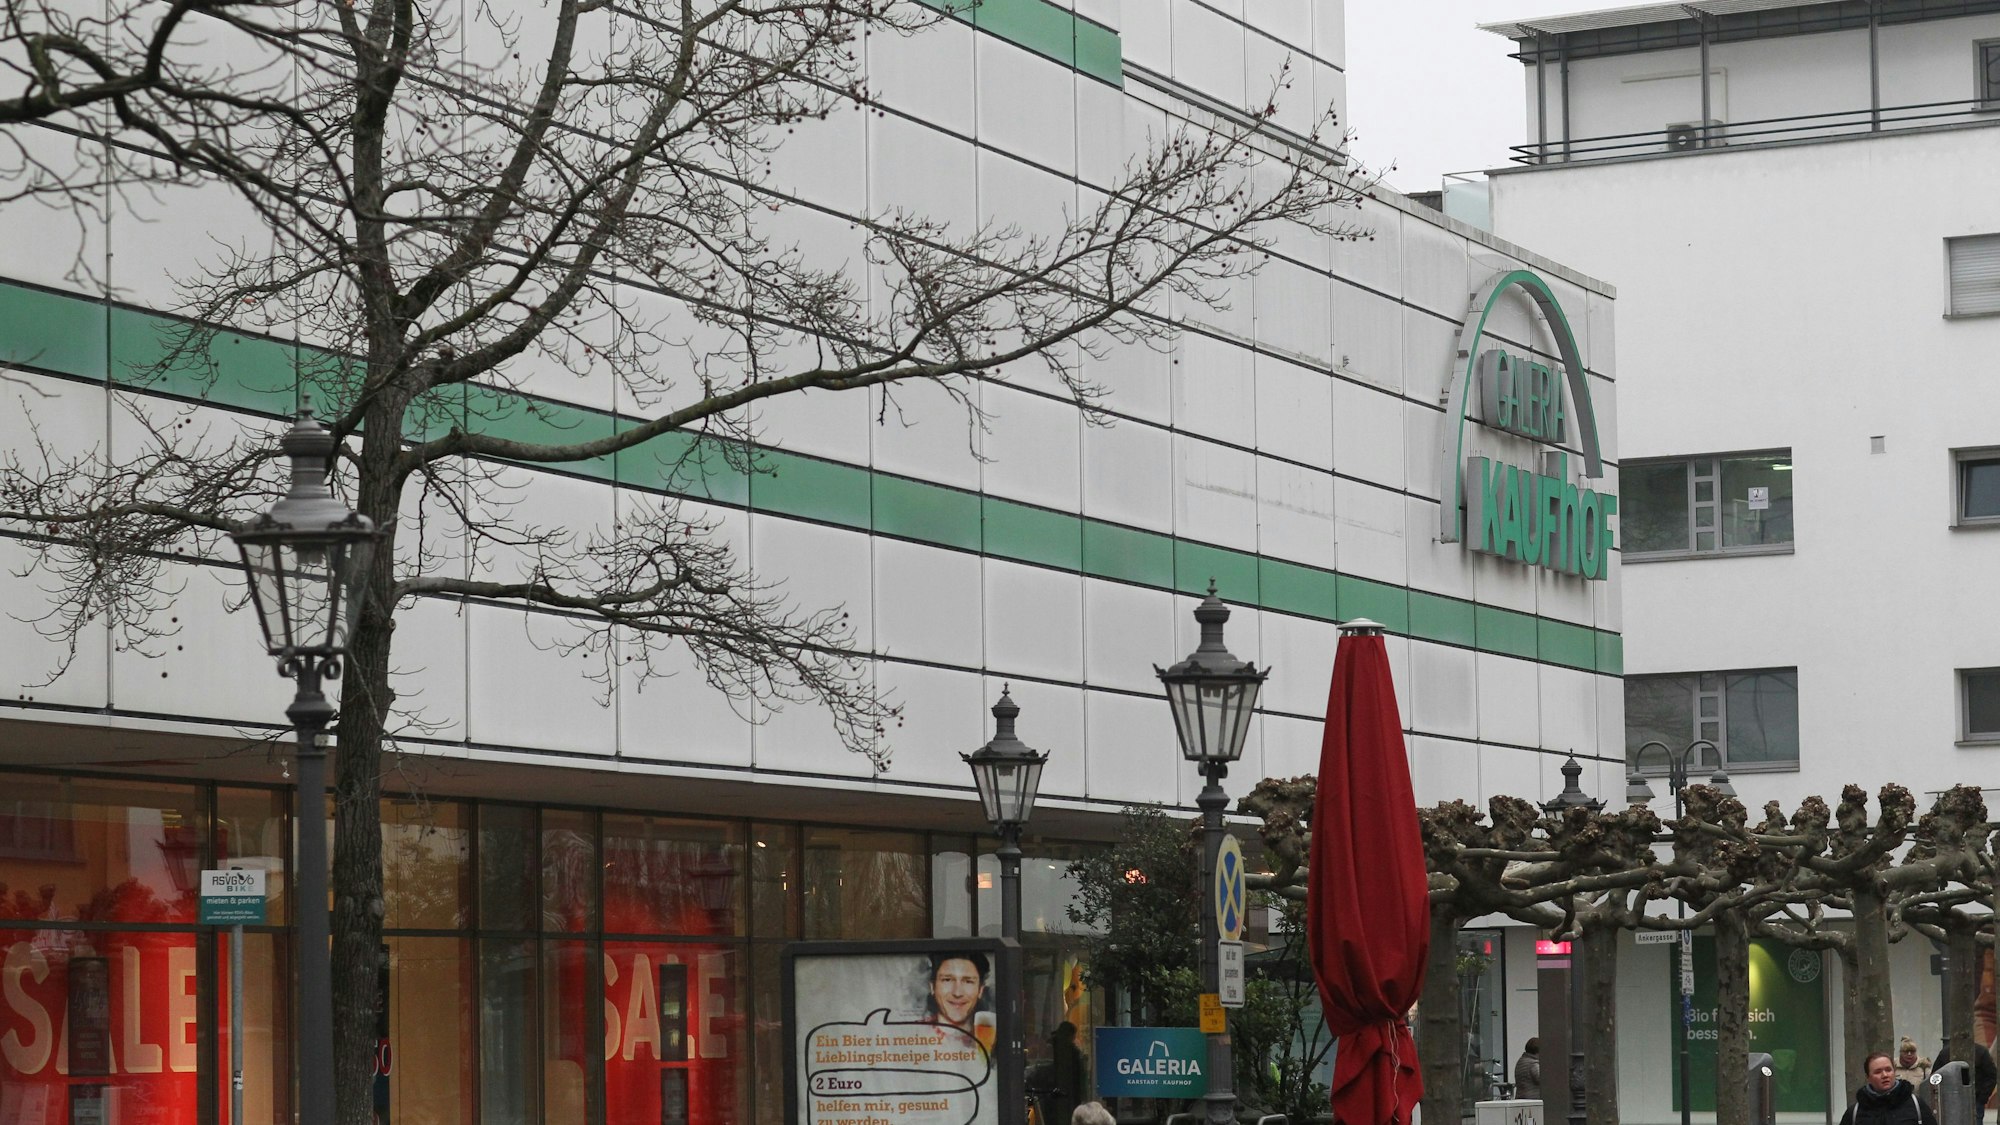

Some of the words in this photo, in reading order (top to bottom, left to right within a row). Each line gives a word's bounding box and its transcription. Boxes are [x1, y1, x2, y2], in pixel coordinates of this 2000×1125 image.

[1485, 348, 1566, 443] GALERIA
[206, 897, 229, 905] mieten
[237, 897, 260, 906] parken
[1638, 933, 1674, 942] Ankergasse
[1748, 1007, 1775, 1022] sich
[816, 1034, 838, 1047] Ein
[842, 1034, 871, 1047] Bier
[875, 1034, 890, 1046] in
[893, 1034, 943, 1046] meiner
[816, 1051, 930, 1065] Lieblingskneipe
[934, 1050, 976, 1062] kostet
[1117, 1058, 1202, 1075] GALERIA
[816, 1078, 824, 1090] 2
[828, 1077, 863, 1090] Euro
[816, 1100, 861, 1112] helfen
[864, 1100, 895, 1113] mir,
[898, 1099, 949, 1114] gesund
